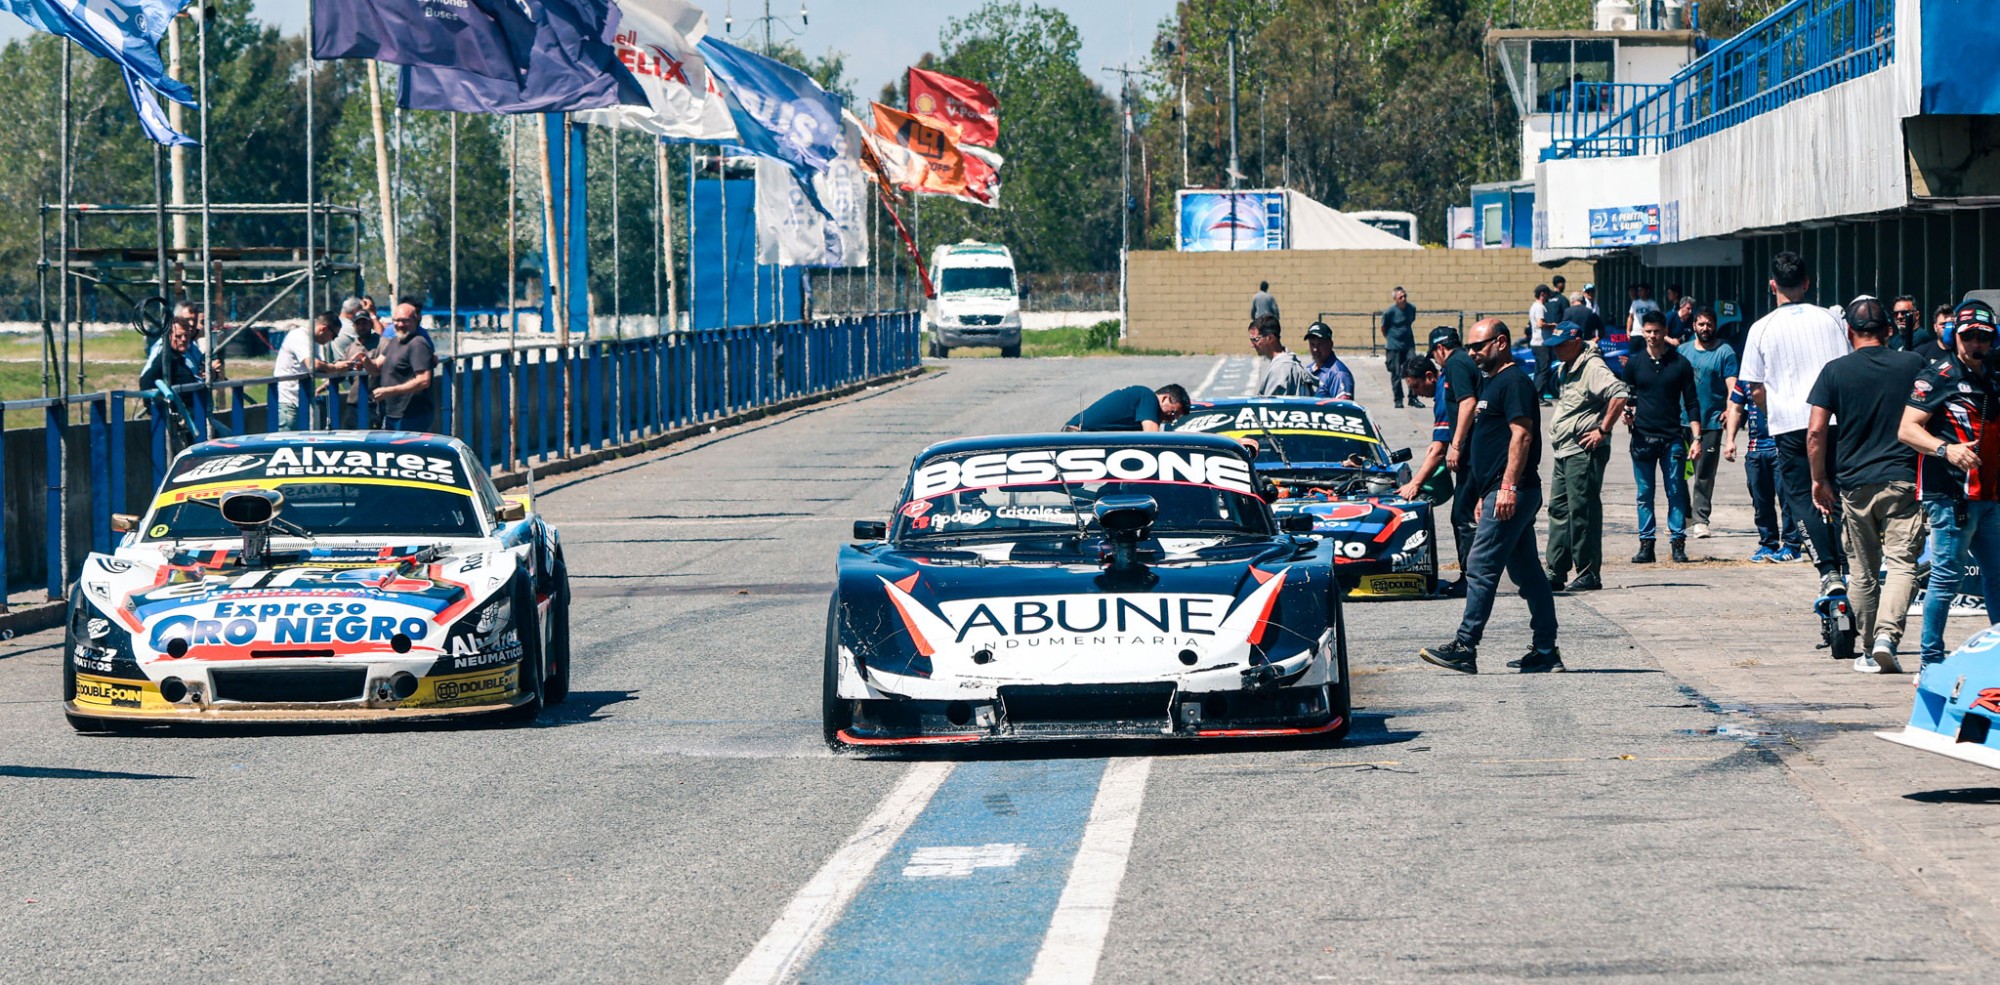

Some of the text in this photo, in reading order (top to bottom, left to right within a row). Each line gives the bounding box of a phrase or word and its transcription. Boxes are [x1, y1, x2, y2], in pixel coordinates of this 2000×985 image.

[425, 7, 458, 20] Buses
[617, 44, 690, 86] ELIX
[1235, 407, 1363, 428] Alvarez
[1235, 421, 1366, 435] NEUMATICOS
[266, 447, 452, 473] Alvarez
[265, 466, 455, 484] NEUMATICOS
[913, 449, 1251, 500] BESSONE
[156, 526, 165, 535] P
[311, 588, 399, 599] RAMOS
[214, 601, 366, 623] Expreso
[955, 597, 1215, 643] ABUNE
[150, 614, 428, 651] ORO NEGRO
[971, 636, 1199, 653] INDUMENTARIA
[455, 645, 523, 668] NEUMATICOS
[81, 683, 142, 702] DOUBLECOIN
